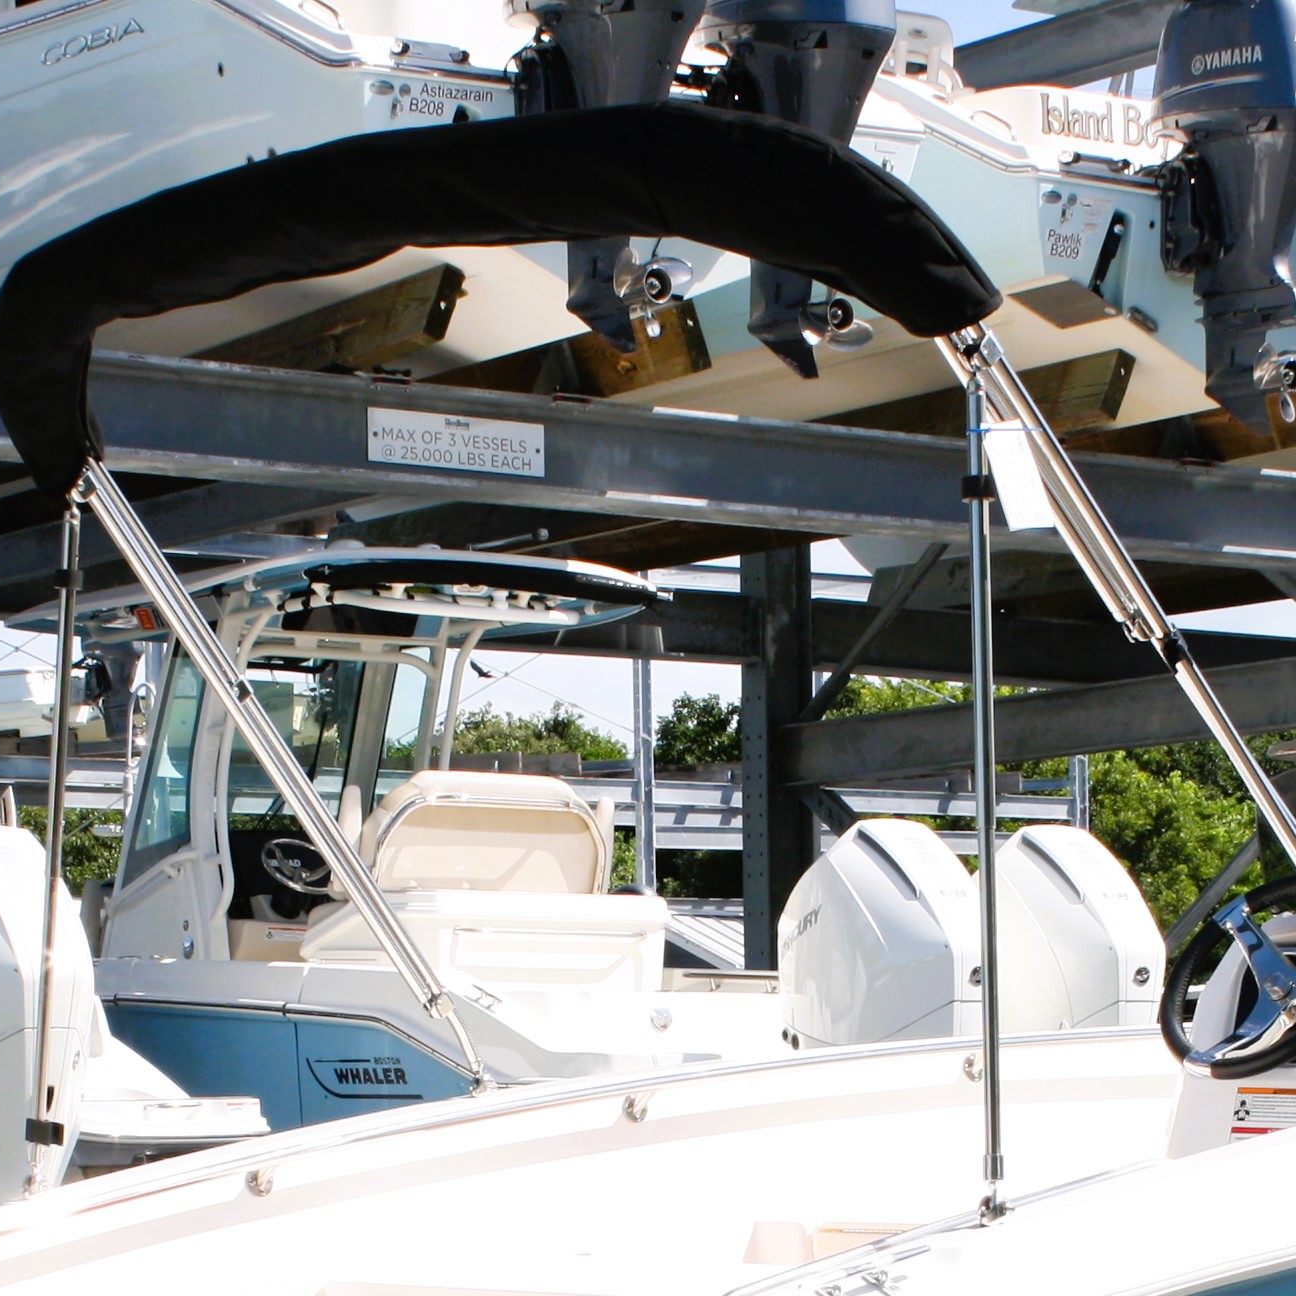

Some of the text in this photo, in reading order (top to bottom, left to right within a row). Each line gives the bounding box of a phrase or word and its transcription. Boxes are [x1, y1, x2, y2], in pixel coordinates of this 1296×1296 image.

[41, 18, 145, 66] COBIA
[1205, 44, 1263, 70] YAMAHA
[420, 82, 493, 102] Astiazarain
[409, 97, 444, 116] B208
[1040, 92, 1114, 143] Island
[1047, 229, 1082, 247] Pawlik
[1050, 242, 1079, 259] B209
[381, 427, 527, 454] MAX OF 3 VESSELS
[381, 444, 532, 471] @ 25,000 LBS EACH
[373, 1056, 401, 1065] BOSTON
[333, 1067, 408, 1085] WHALER
